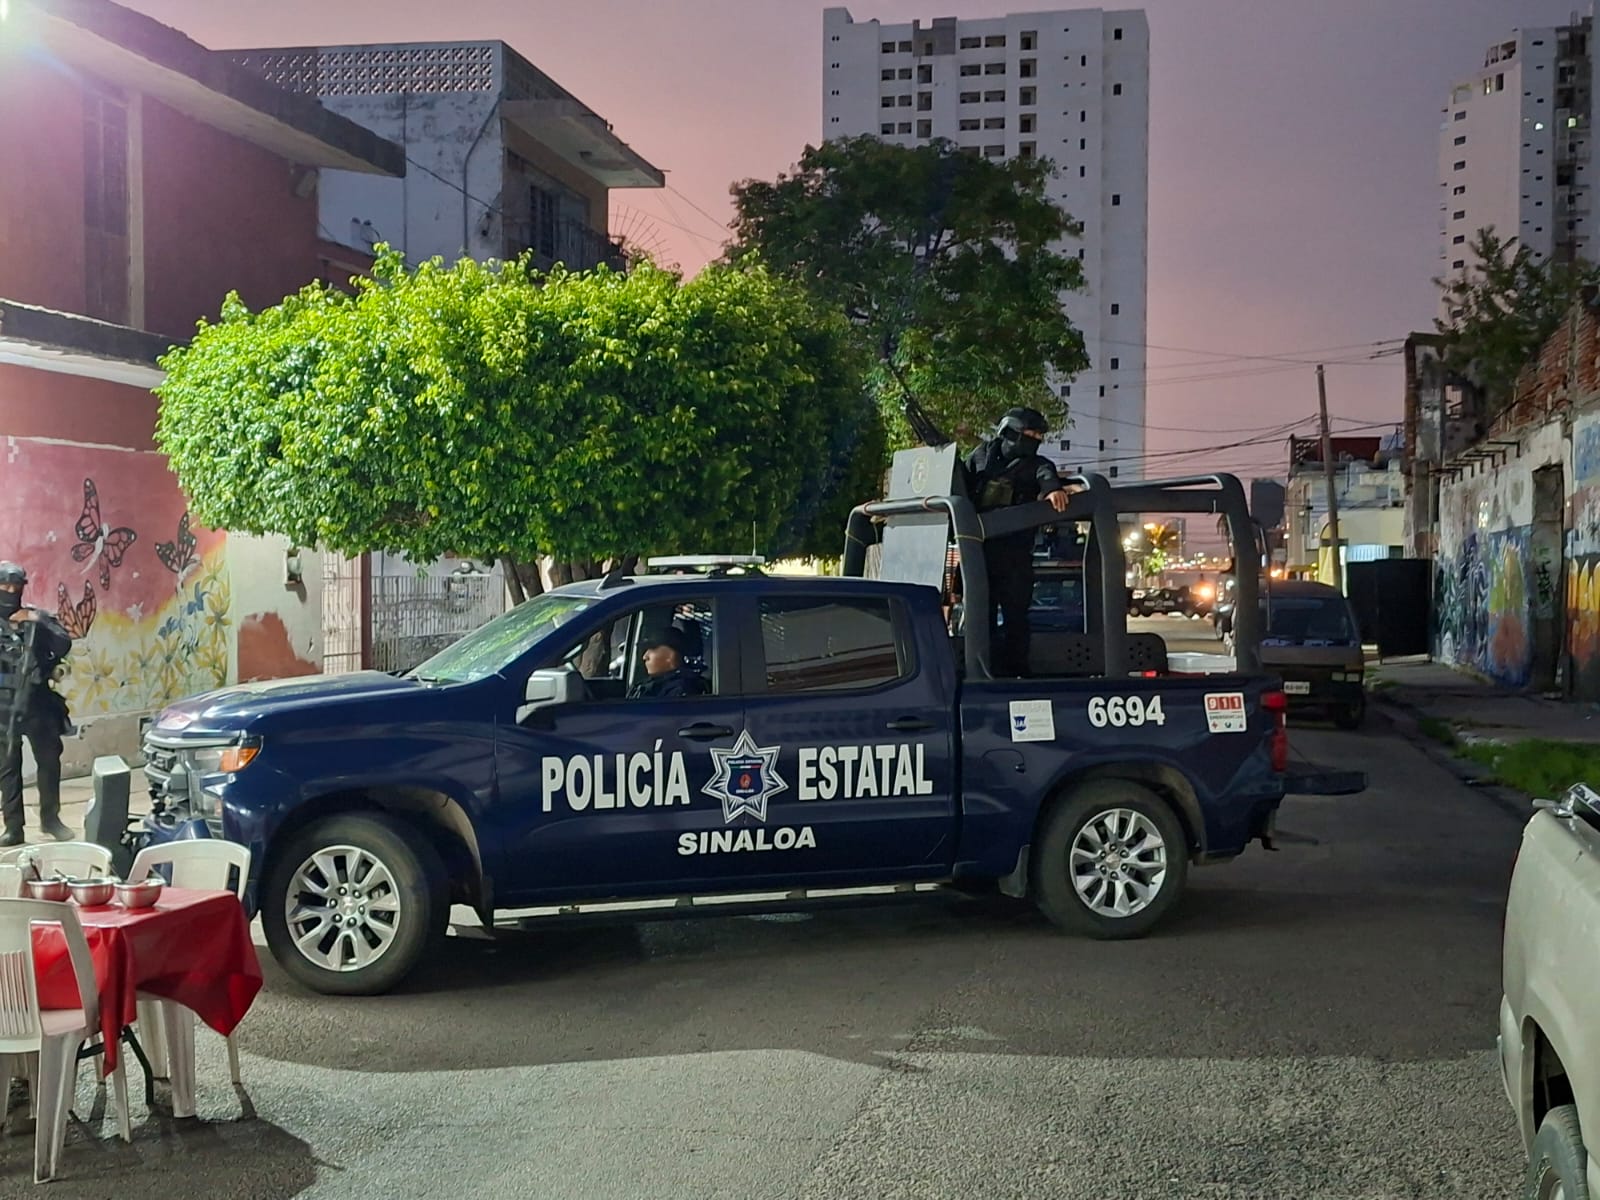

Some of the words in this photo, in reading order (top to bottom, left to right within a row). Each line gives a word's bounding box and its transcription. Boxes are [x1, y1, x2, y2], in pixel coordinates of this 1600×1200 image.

[1088, 695, 1166, 728] 6694
[1208, 698, 1239, 709] 911
[541, 739, 691, 812] POLICÍA
[798, 743, 934, 801] ESTATAL
[677, 826, 817, 856] SINALOA
